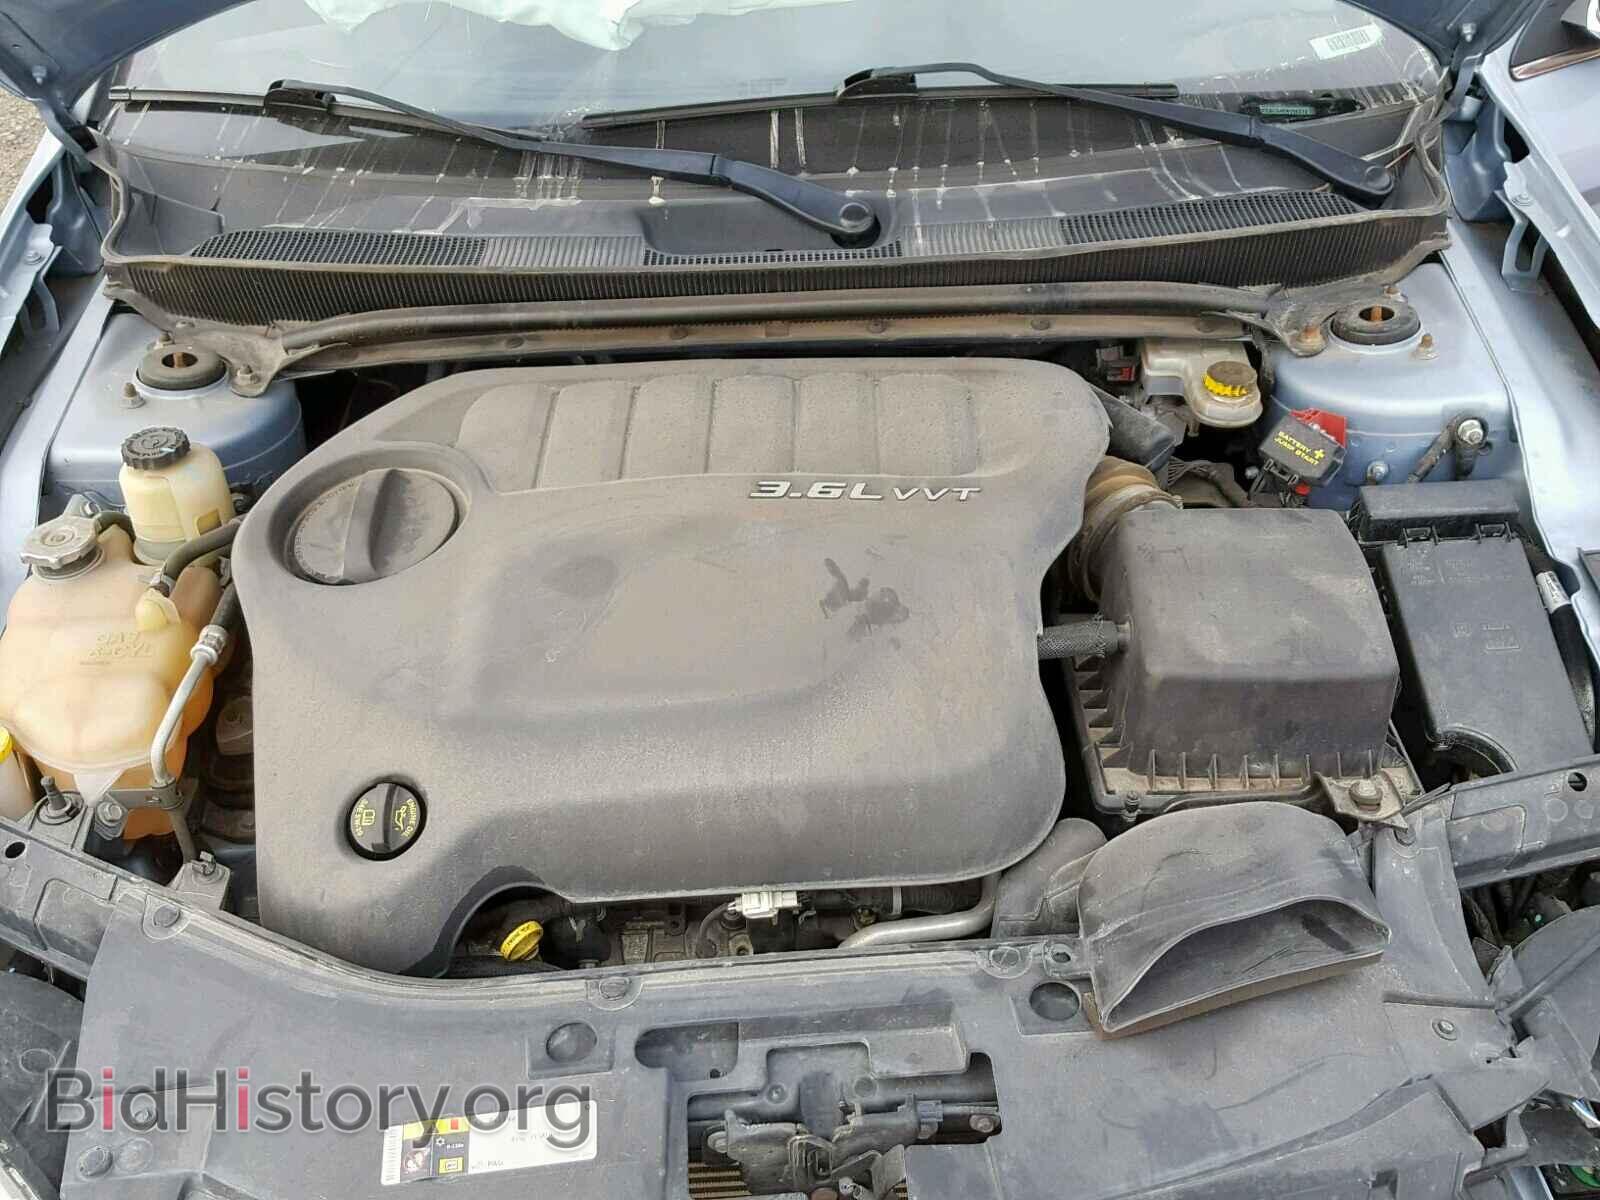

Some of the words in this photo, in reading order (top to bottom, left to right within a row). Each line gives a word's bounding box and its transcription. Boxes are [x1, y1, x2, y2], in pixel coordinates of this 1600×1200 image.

[1278, 431, 1312, 454] BATTERY
[1295, 449, 1319, 465] START
[750, 480, 884, 500] 3.6L
[893, 486, 982, 501] VVT
[406, 798, 417, 824] ENGINE
[401, 825, 414, 837] OIL
